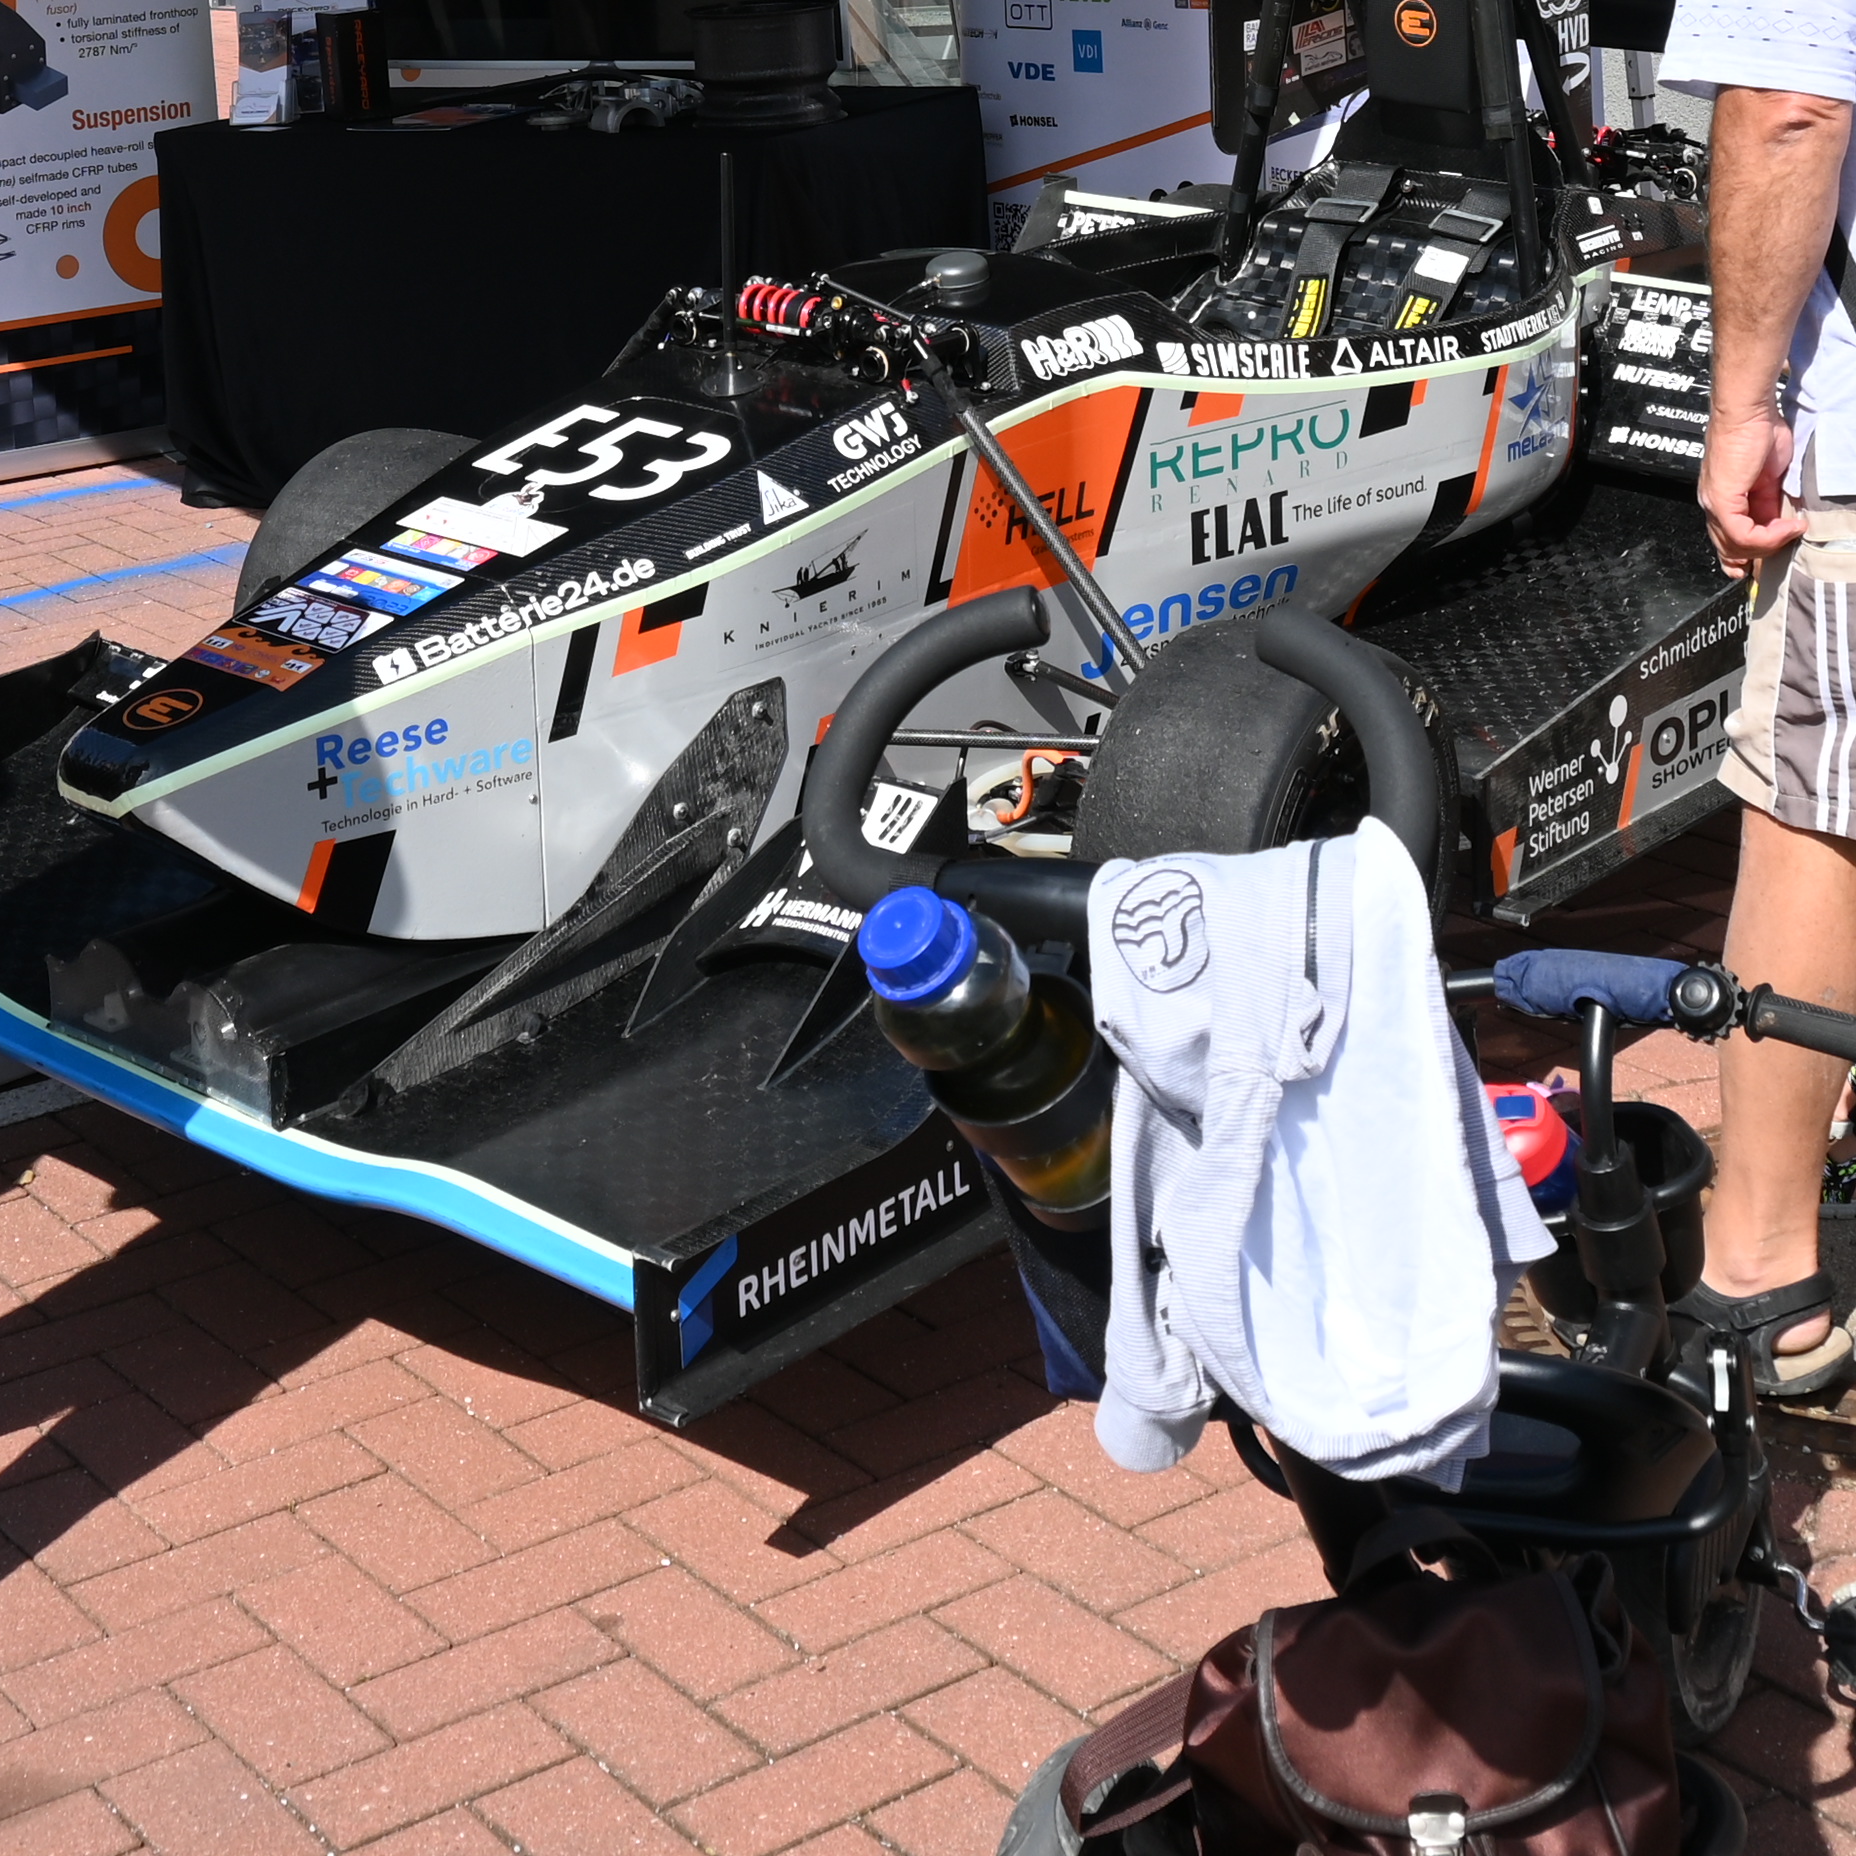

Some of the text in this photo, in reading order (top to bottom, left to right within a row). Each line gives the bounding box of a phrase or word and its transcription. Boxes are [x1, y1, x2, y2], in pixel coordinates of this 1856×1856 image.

[46, 2, 77, 16] fusor)
[67, 6, 198, 31] fully laminated fronthoop
[1010, 4, 1048, 20] OTT
[1122, 18, 1142, 28] Allianz
[70, 23, 181, 44] torsional stiffness of
[1558, 13, 1589, 54] HVD
[78, 46, 107, 58] 2787
[354, 19, 371, 110] RACEYARD
[1078, 45, 1098, 58] VDI
[1008, 62, 1055, 81] VDE
[72, 98, 191, 132] Suspension
[1020, 116, 1058, 127] HONSEL
[30, 148, 87, 167] decoupled
[91, 141, 144, 158] heave-roll
[19, 169, 69, 186] selfmade
[72, 164, 104, 178] CFRP
[107, 160, 138, 174] tubes
[80, 185, 101, 197] and
[16, 202, 92, 221] made 10 inch
[25, 218, 85, 235] CFRP rims
[1583, 243, 1624, 260] RACING
[1480, 309, 1549, 352] STADTWERKE
[1196, 343, 1311, 379] SIMSCALE
[1368, 335, 1461, 367] ALTAIR
[1613, 363, 1694, 392] NUTECH
[1150, 407, 1350, 489] REPRO
[827, 435, 922, 495] TECHNOLOGY
[1151, 451, 1348, 513] RENARD
[765, 488, 797, 516] Sika
[1293, 493, 1372, 522] The life of
[1191, 490, 1288, 566] ELAC
[415, 554, 656, 670] Batterie24.de
[724, 568, 911, 644] KNIERIM
[316, 718, 449, 770] Reese
[1529, 754, 1586, 796] Werner
[321, 770, 533, 833] Technologie in Hard- Software
[1529, 779, 1594, 826] Petersen
[1529, 810, 1590, 858] Stiftung
[735, 1158, 972, 1318] RHEINMETALL
